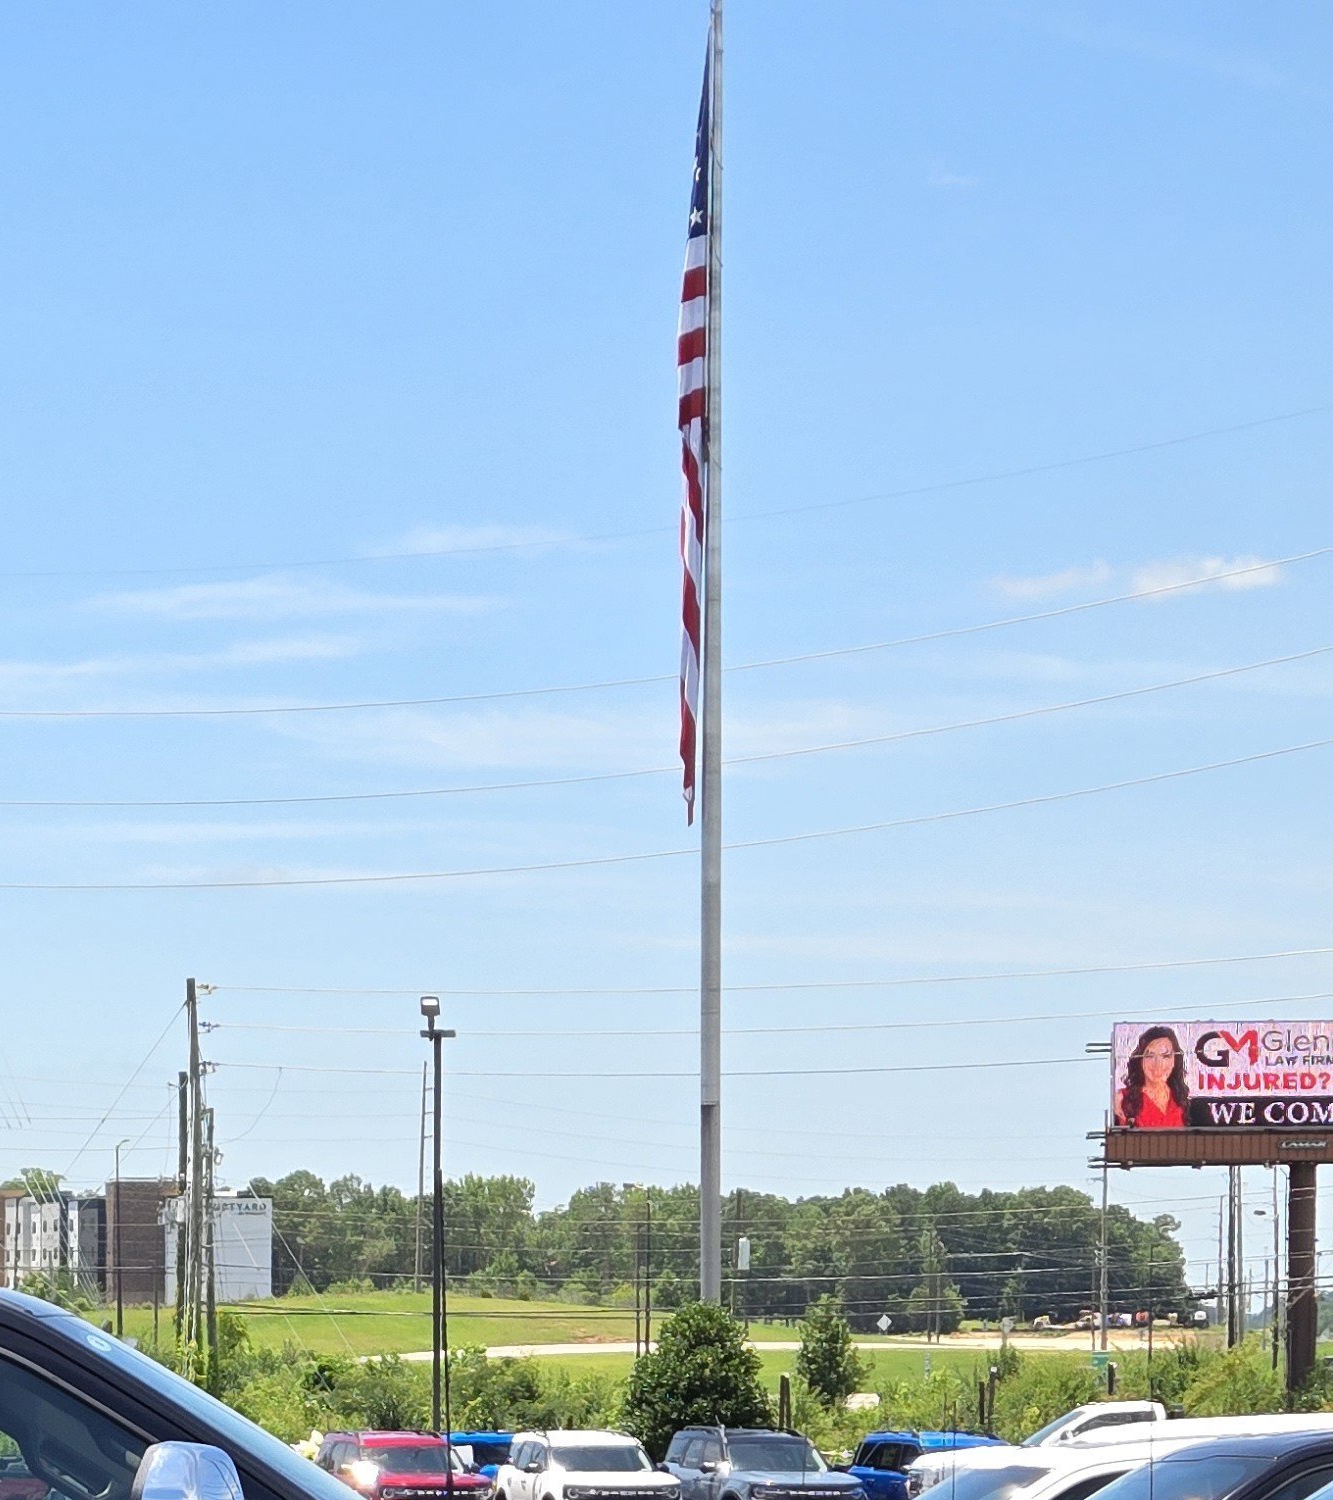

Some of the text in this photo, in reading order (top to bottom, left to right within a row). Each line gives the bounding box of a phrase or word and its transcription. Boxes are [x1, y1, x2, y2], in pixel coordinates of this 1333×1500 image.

[1195, 1029, 1259, 1068] GM
[1261, 1029, 1333, 1052] Glen
[1265, 1055, 1298, 1066] LAW
[1198, 1071, 1331, 1091] INJURED?
[1208, 1102, 1256, 1125] WE
